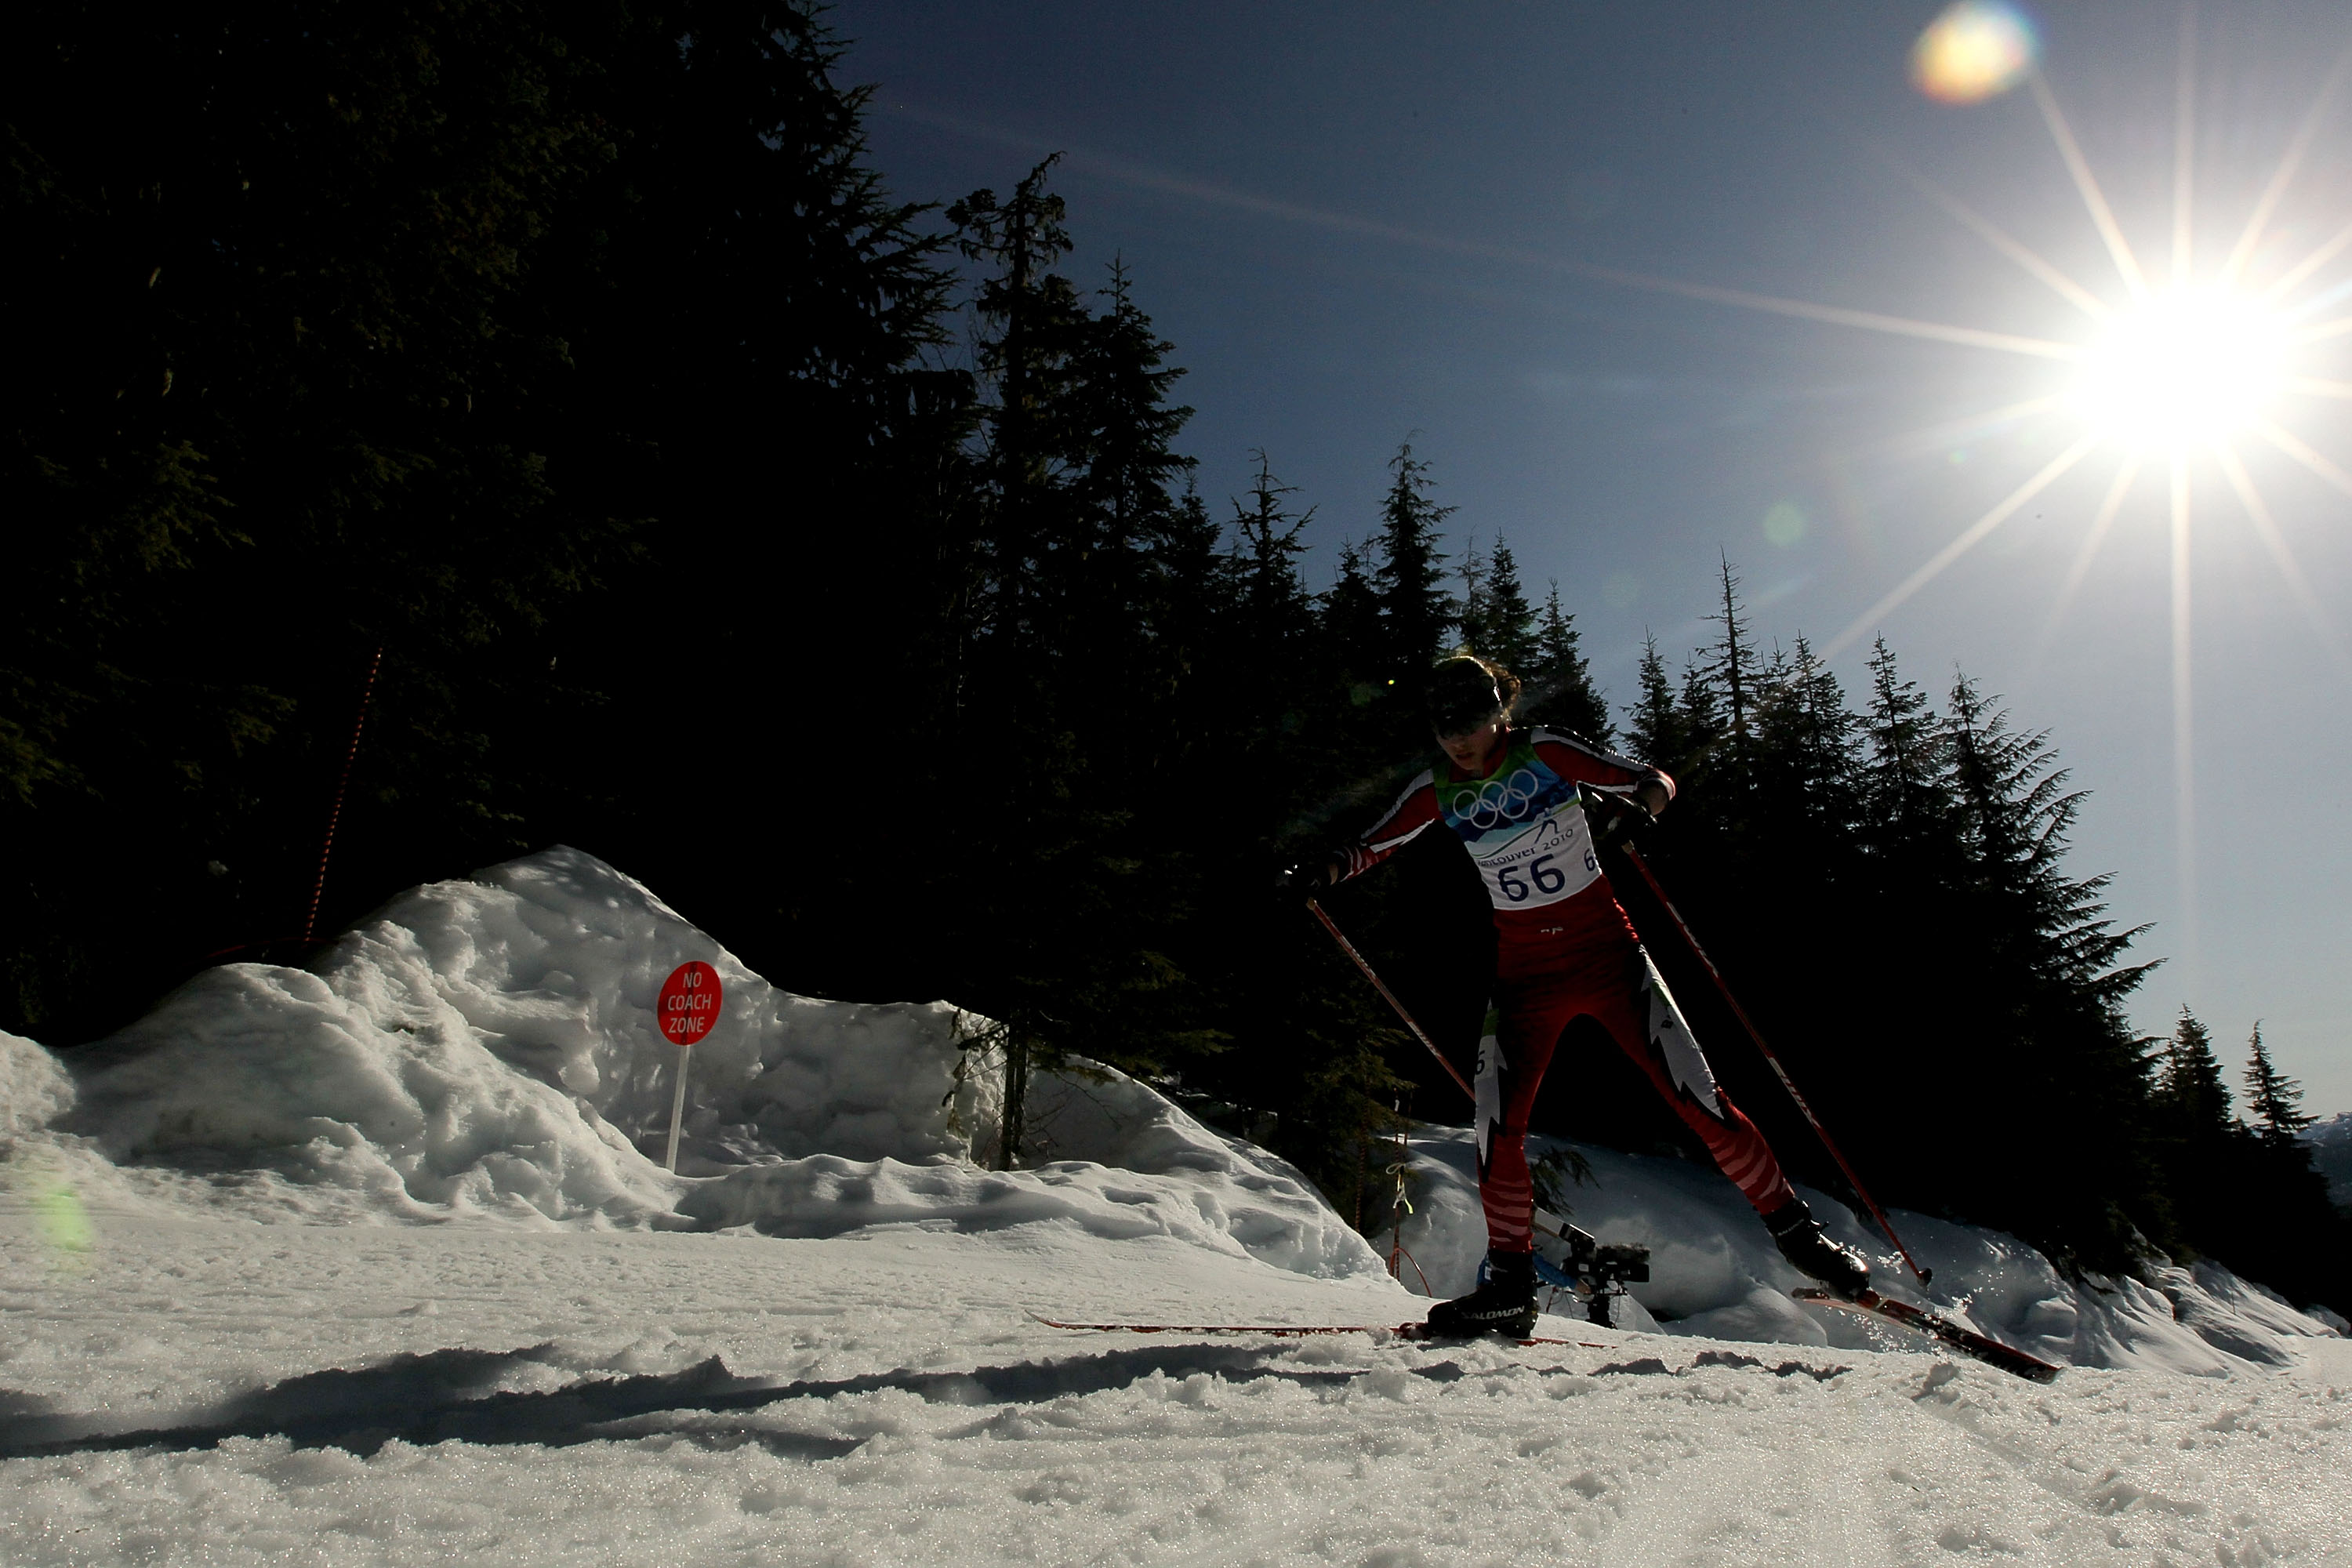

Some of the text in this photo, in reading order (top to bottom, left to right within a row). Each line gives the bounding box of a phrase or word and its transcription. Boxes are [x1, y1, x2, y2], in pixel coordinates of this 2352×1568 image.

[1542, 829, 1573, 851] 2010
[1497, 854, 1565, 902] 66
[683, 971, 702, 989] NO
[667, 993, 712, 1011] COACH
[668, 1016, 705, 1033] ZONE
[1461, 1305, 1525, 1320] SALOMON
